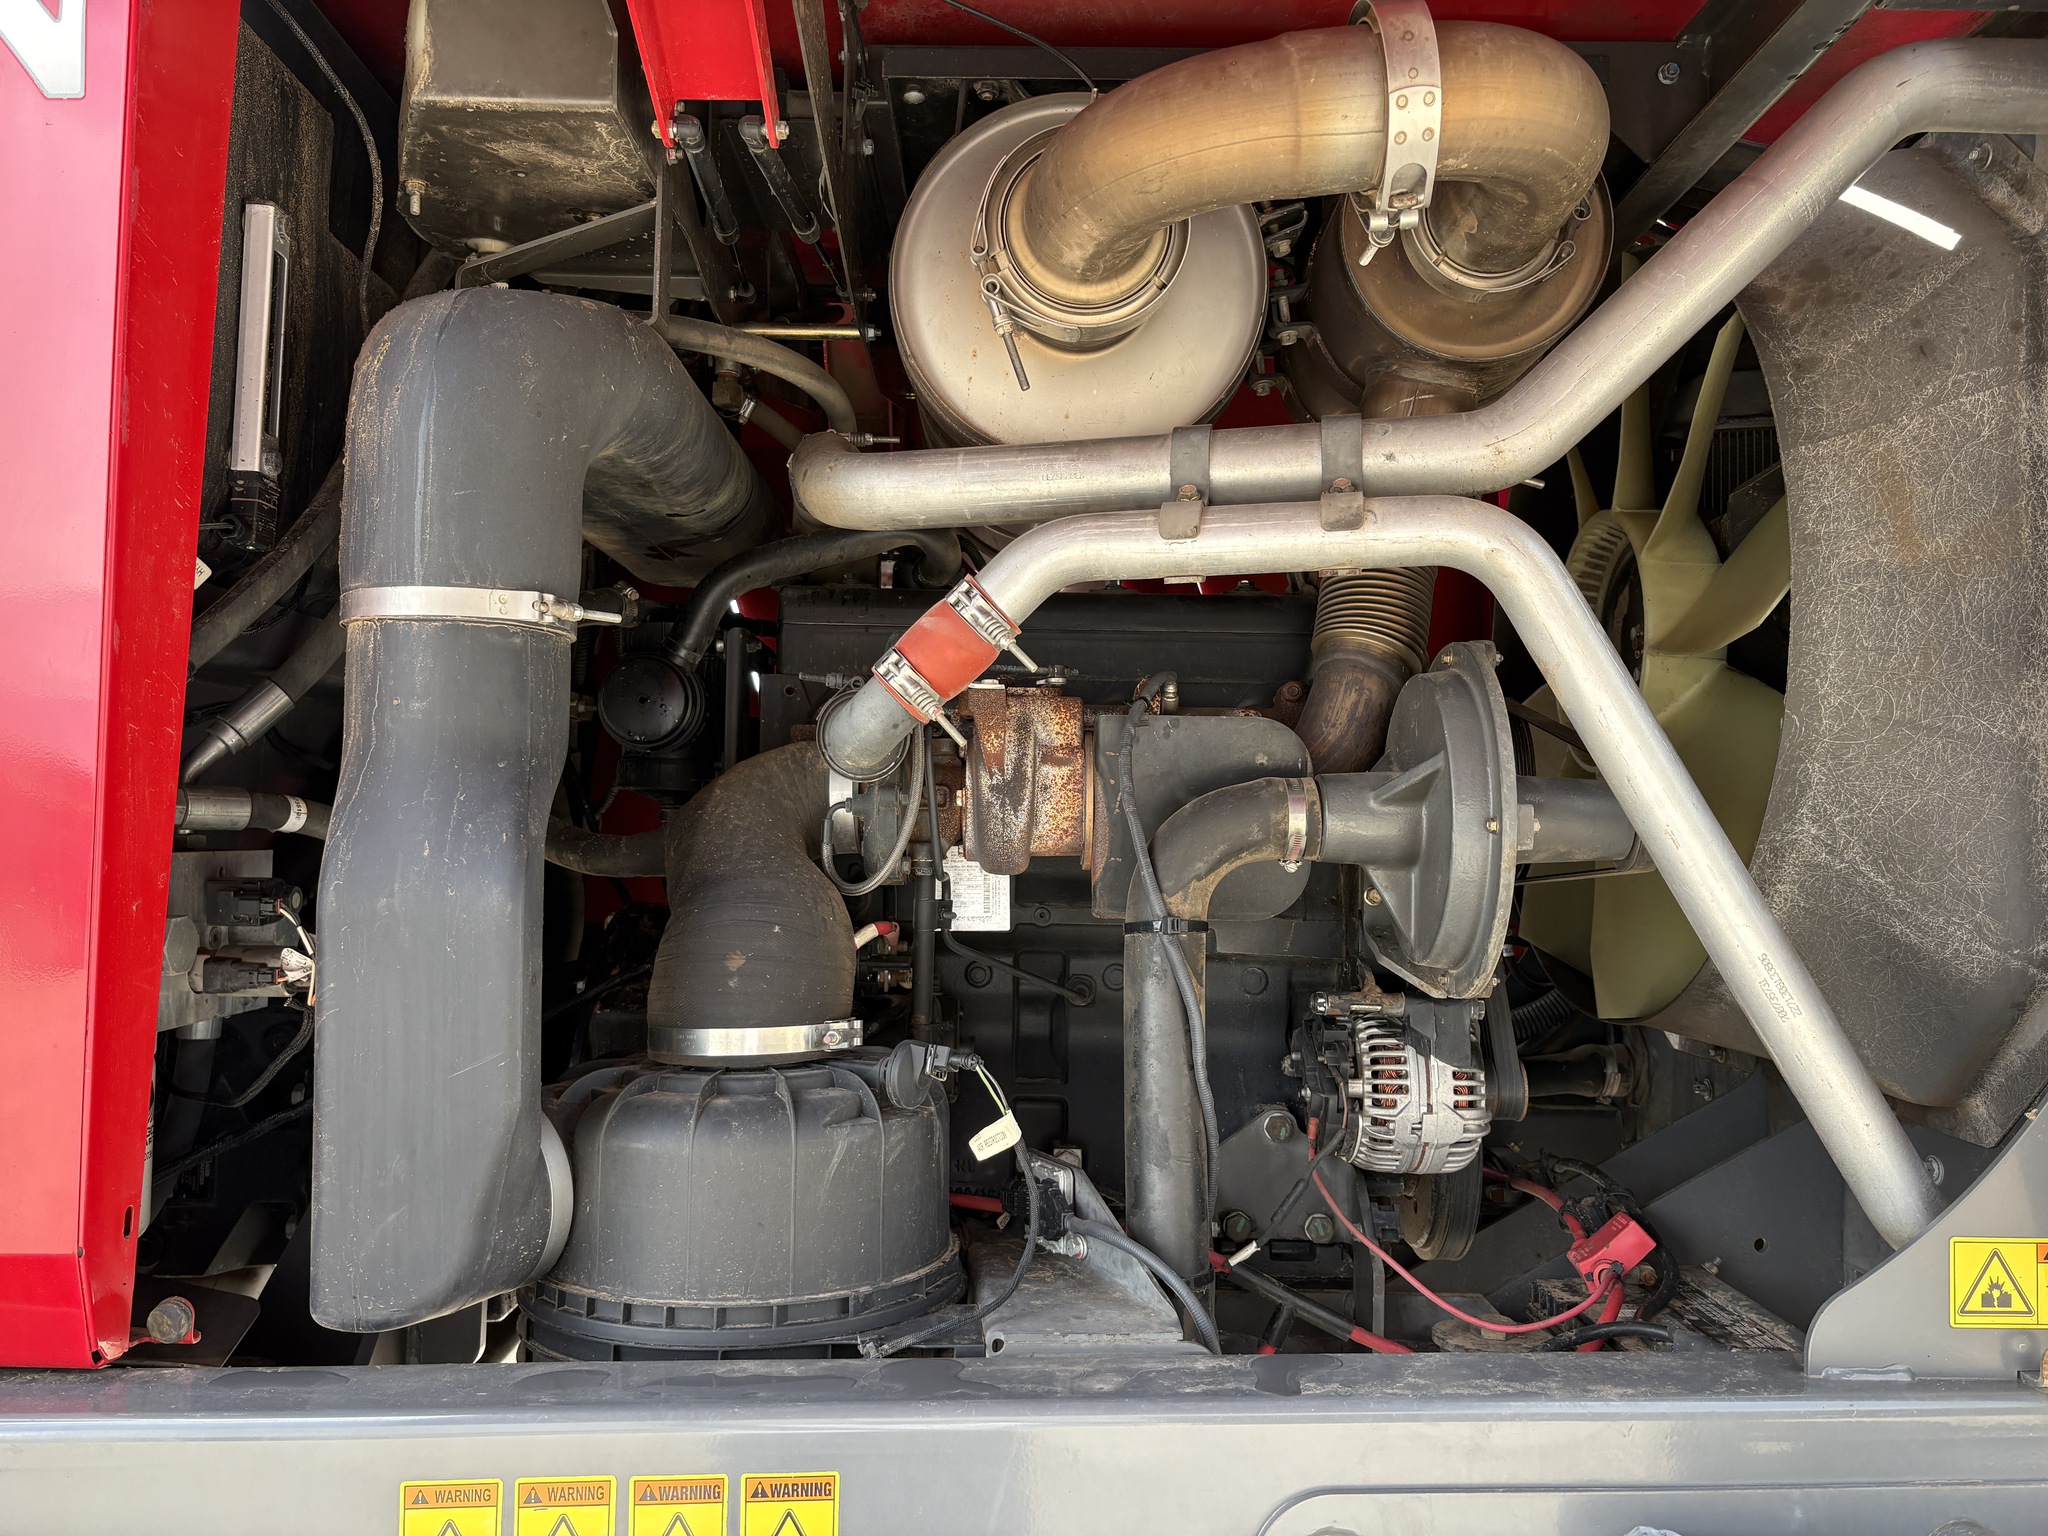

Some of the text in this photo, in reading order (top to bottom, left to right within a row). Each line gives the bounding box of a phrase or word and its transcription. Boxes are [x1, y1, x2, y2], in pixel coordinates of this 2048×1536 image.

[434, 1488, 492, 1503] WARNING
[547, 1486, 605, 1502] WARNING
[658, 1484, 721, 1501] WARNING
[769, 1482, 832, 1498] WARNING
